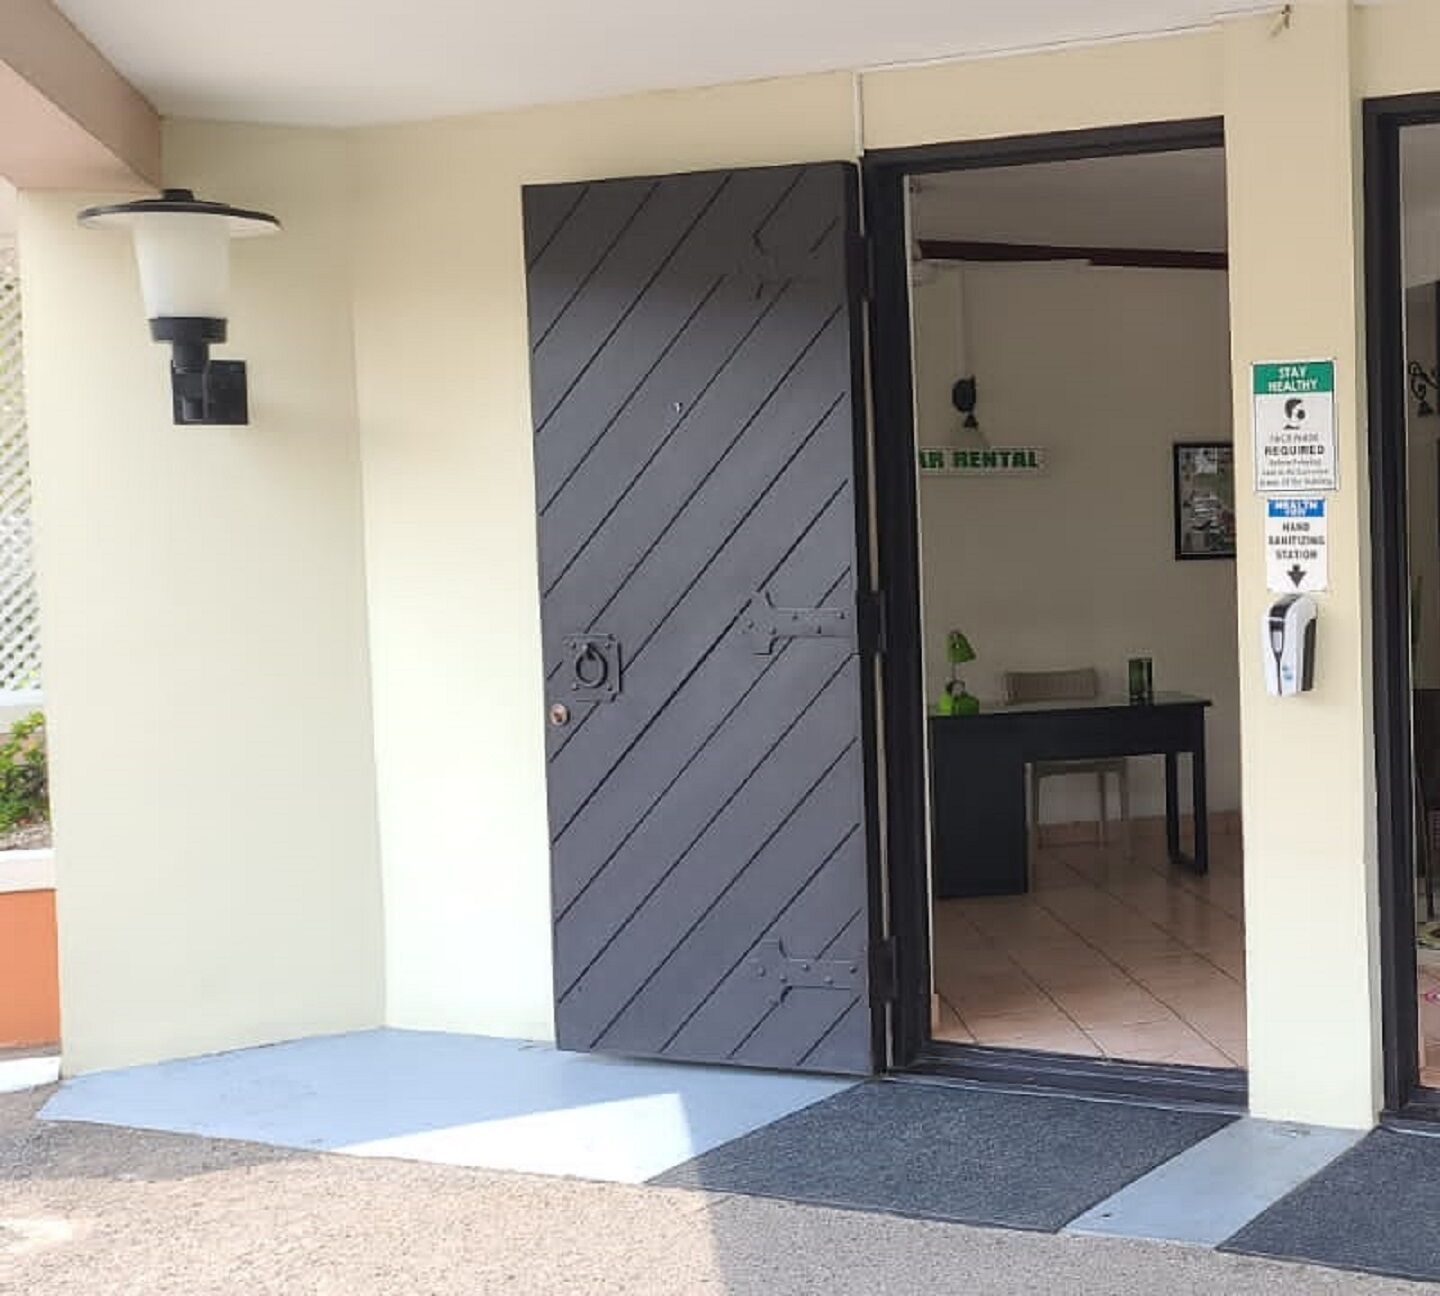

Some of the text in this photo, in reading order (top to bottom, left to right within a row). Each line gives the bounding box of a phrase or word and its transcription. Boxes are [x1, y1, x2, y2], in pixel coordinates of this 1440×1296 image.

[1278, 366, 1307, 379] STAY
[1268, 379, 1319, 392] HEALTHY
[1264, 445, 1325, 456] REQUIRED
[953, 450, 1038, 468] RENTAL
[1282, 521, 1310, 532] HAND
[1268, 535, 1326, 546] SANITIZING
[1275, 549, 1317, 560] STATION
